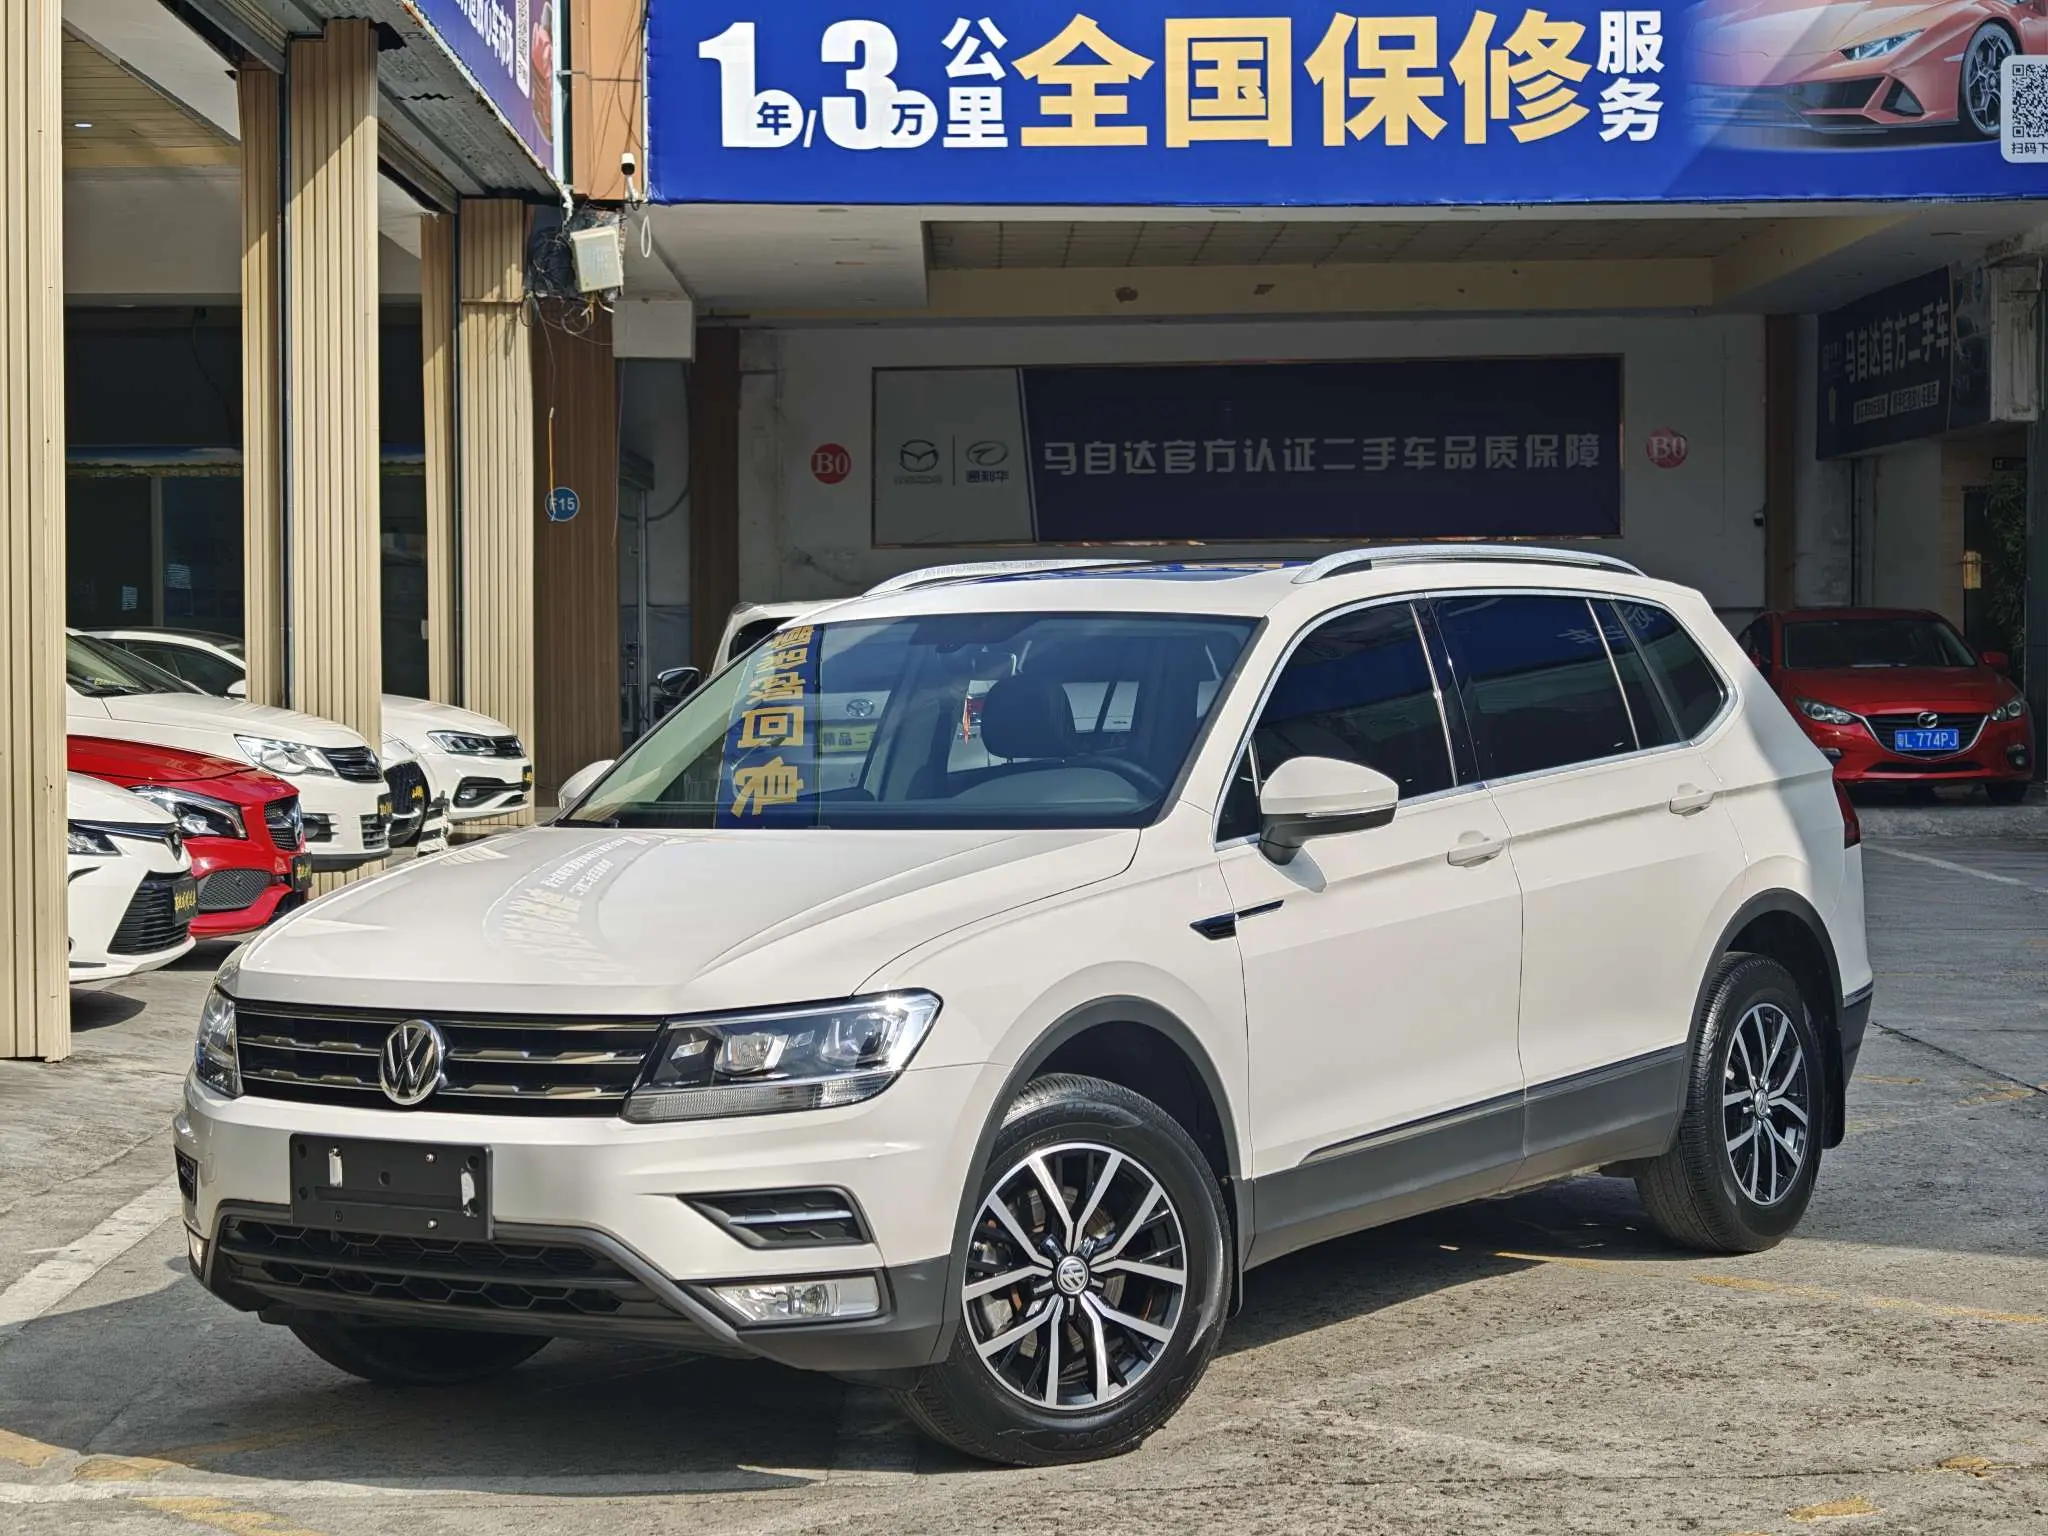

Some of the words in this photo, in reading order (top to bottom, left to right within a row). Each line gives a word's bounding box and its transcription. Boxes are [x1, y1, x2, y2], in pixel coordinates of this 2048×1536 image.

[1044, 433, 1600, 475] 马自达官方认证二手车品质保障
